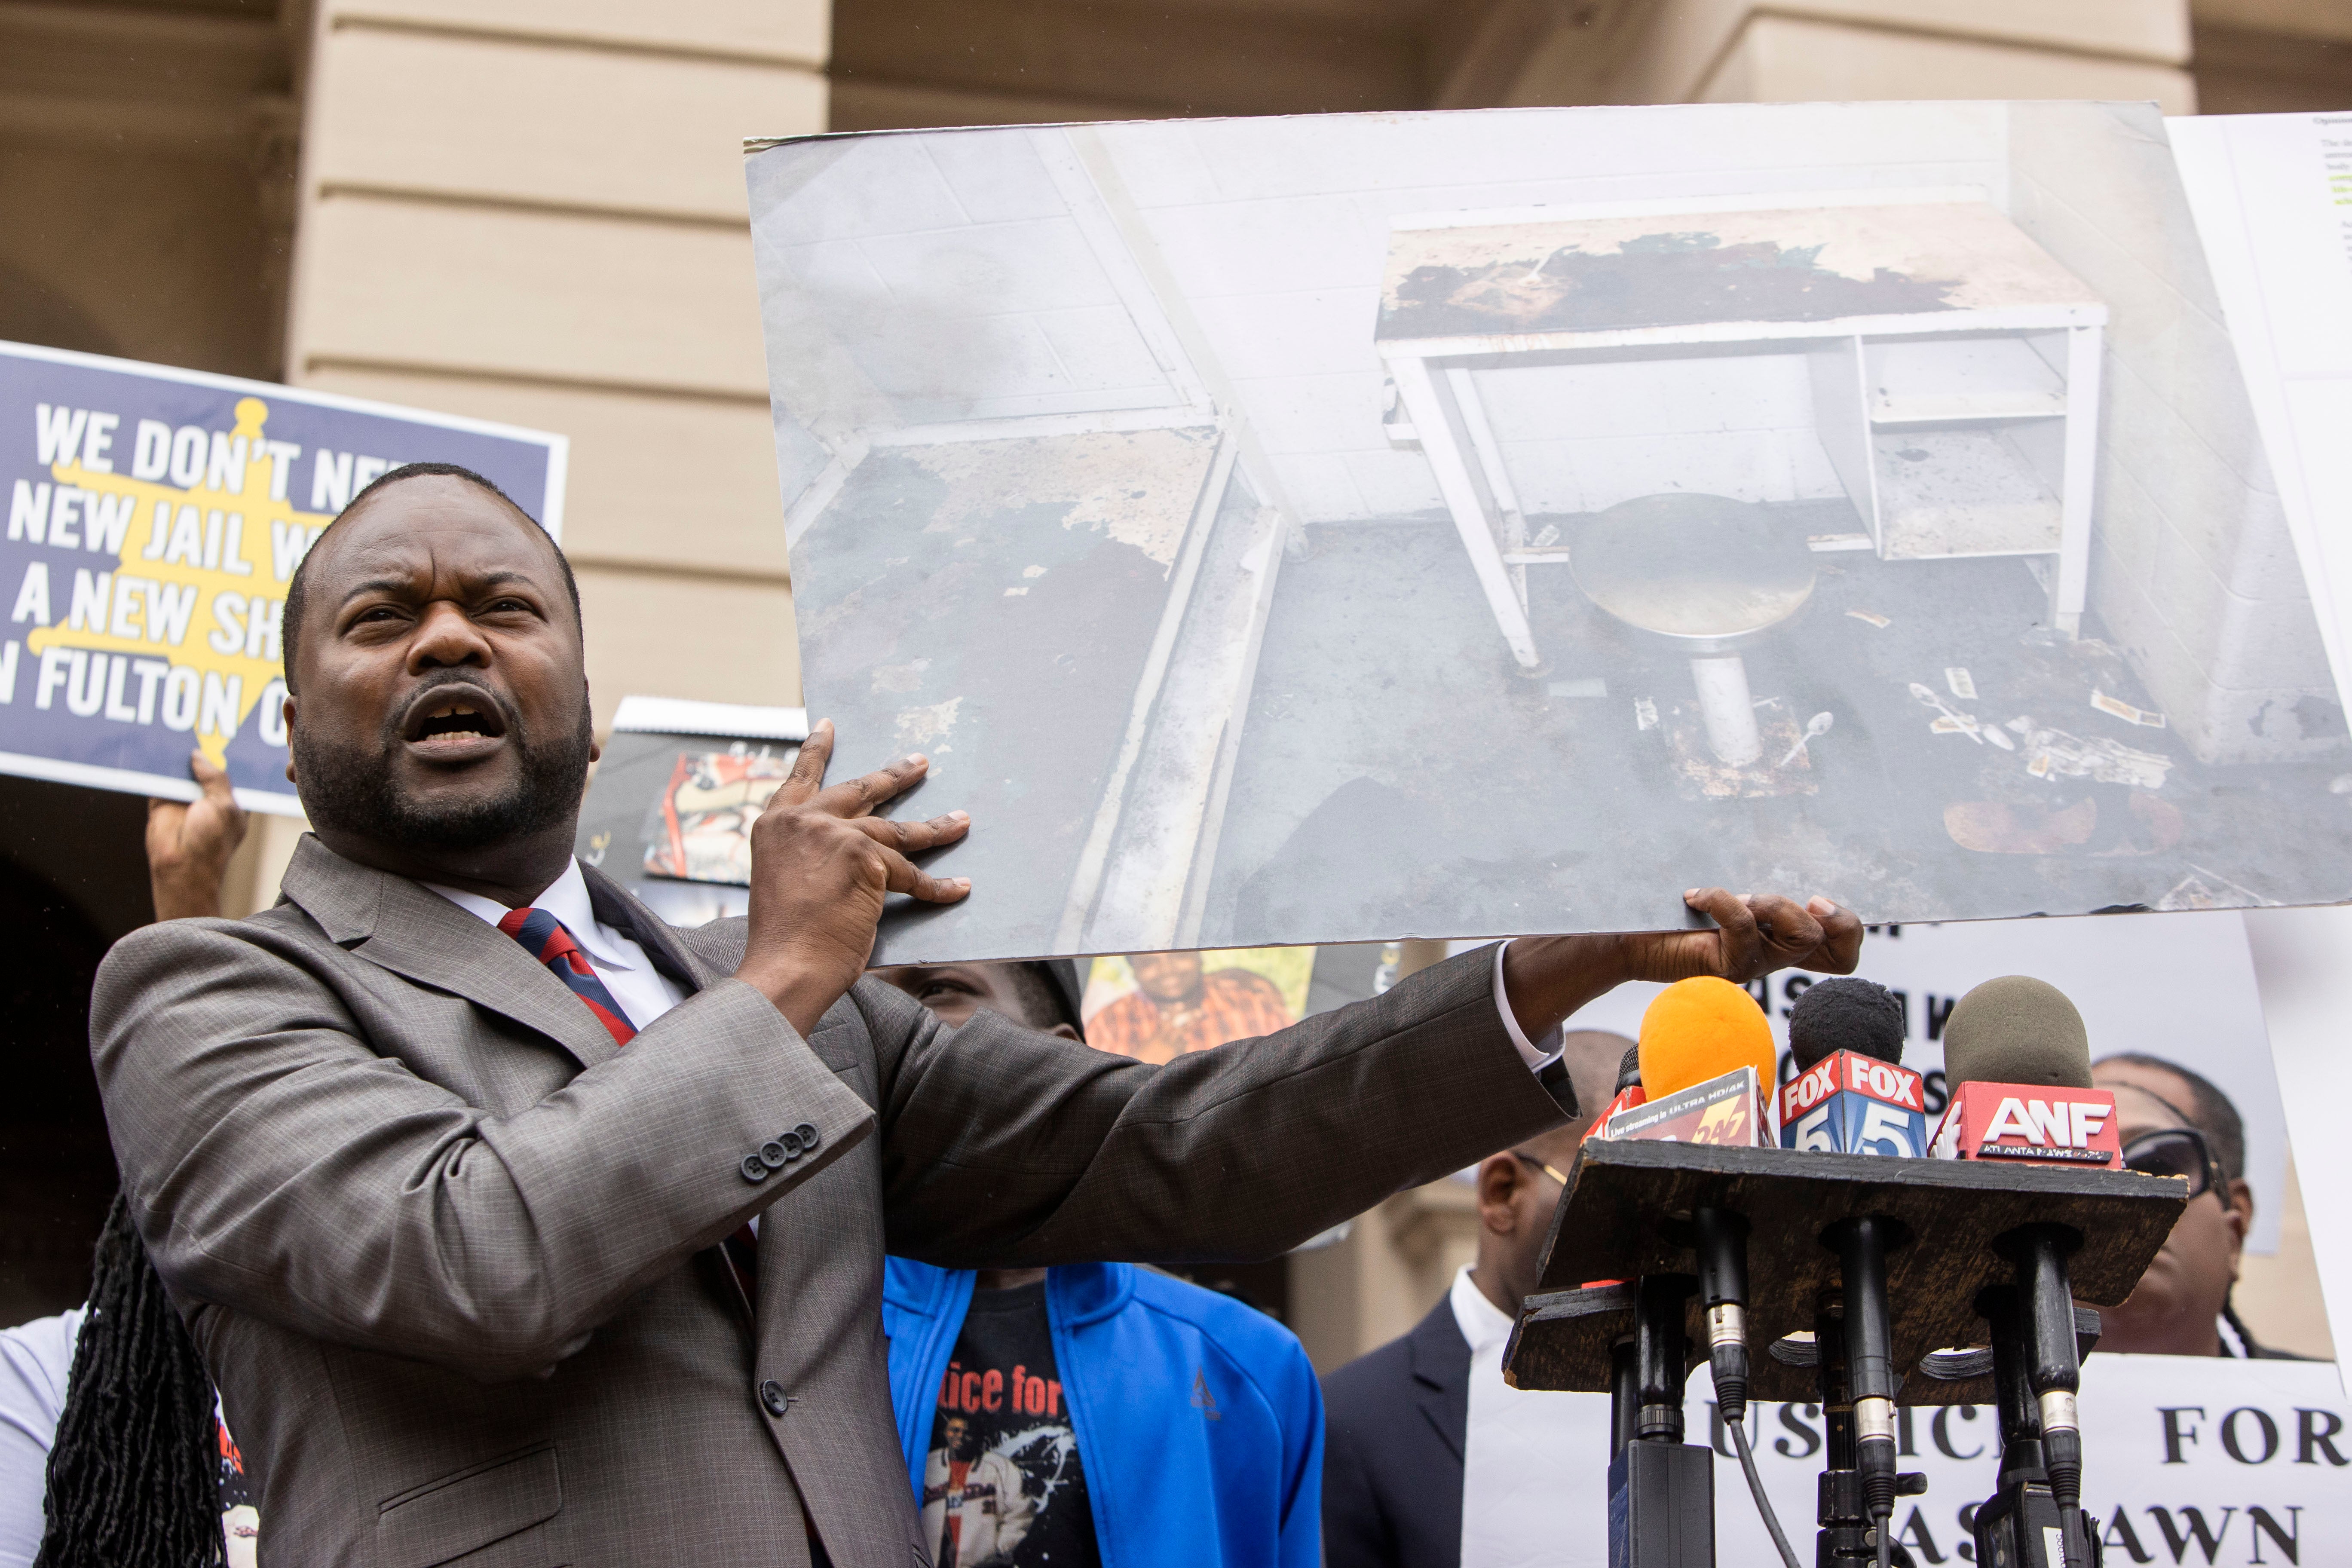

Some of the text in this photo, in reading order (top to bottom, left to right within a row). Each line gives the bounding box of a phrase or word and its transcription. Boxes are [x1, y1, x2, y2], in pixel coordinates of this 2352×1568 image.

[36, 403, 408, 512] WE DON'T NE
[7, 479, 137, 556] NEW
[142, 500, 254, 576] JAIL
[11, 561, 51, 626] A
[68, 568, 199, 646] NEW
[35, 646, 243, 739] FULTON
[1610, 1126, 1625, 1137] Live
[1625, 1114, 1659, 1133] streaming
[1660, 1111, 1667, 1120] in
[1669, 1096, 1706, 1115] ULTRA
[1708, 1080, 1745, 1101] HD/4K
[1784, 1059, 1835, 1121] FOX
[1850, 1057, 1918, 1107] FOX
[1862, 1101, 1913, 1158] 5
[1982, 1097, 2112, 1148] ANF
[1012, 1365, 1063, 1418] for
[2156, 1406, 2352, 1466] FOR
